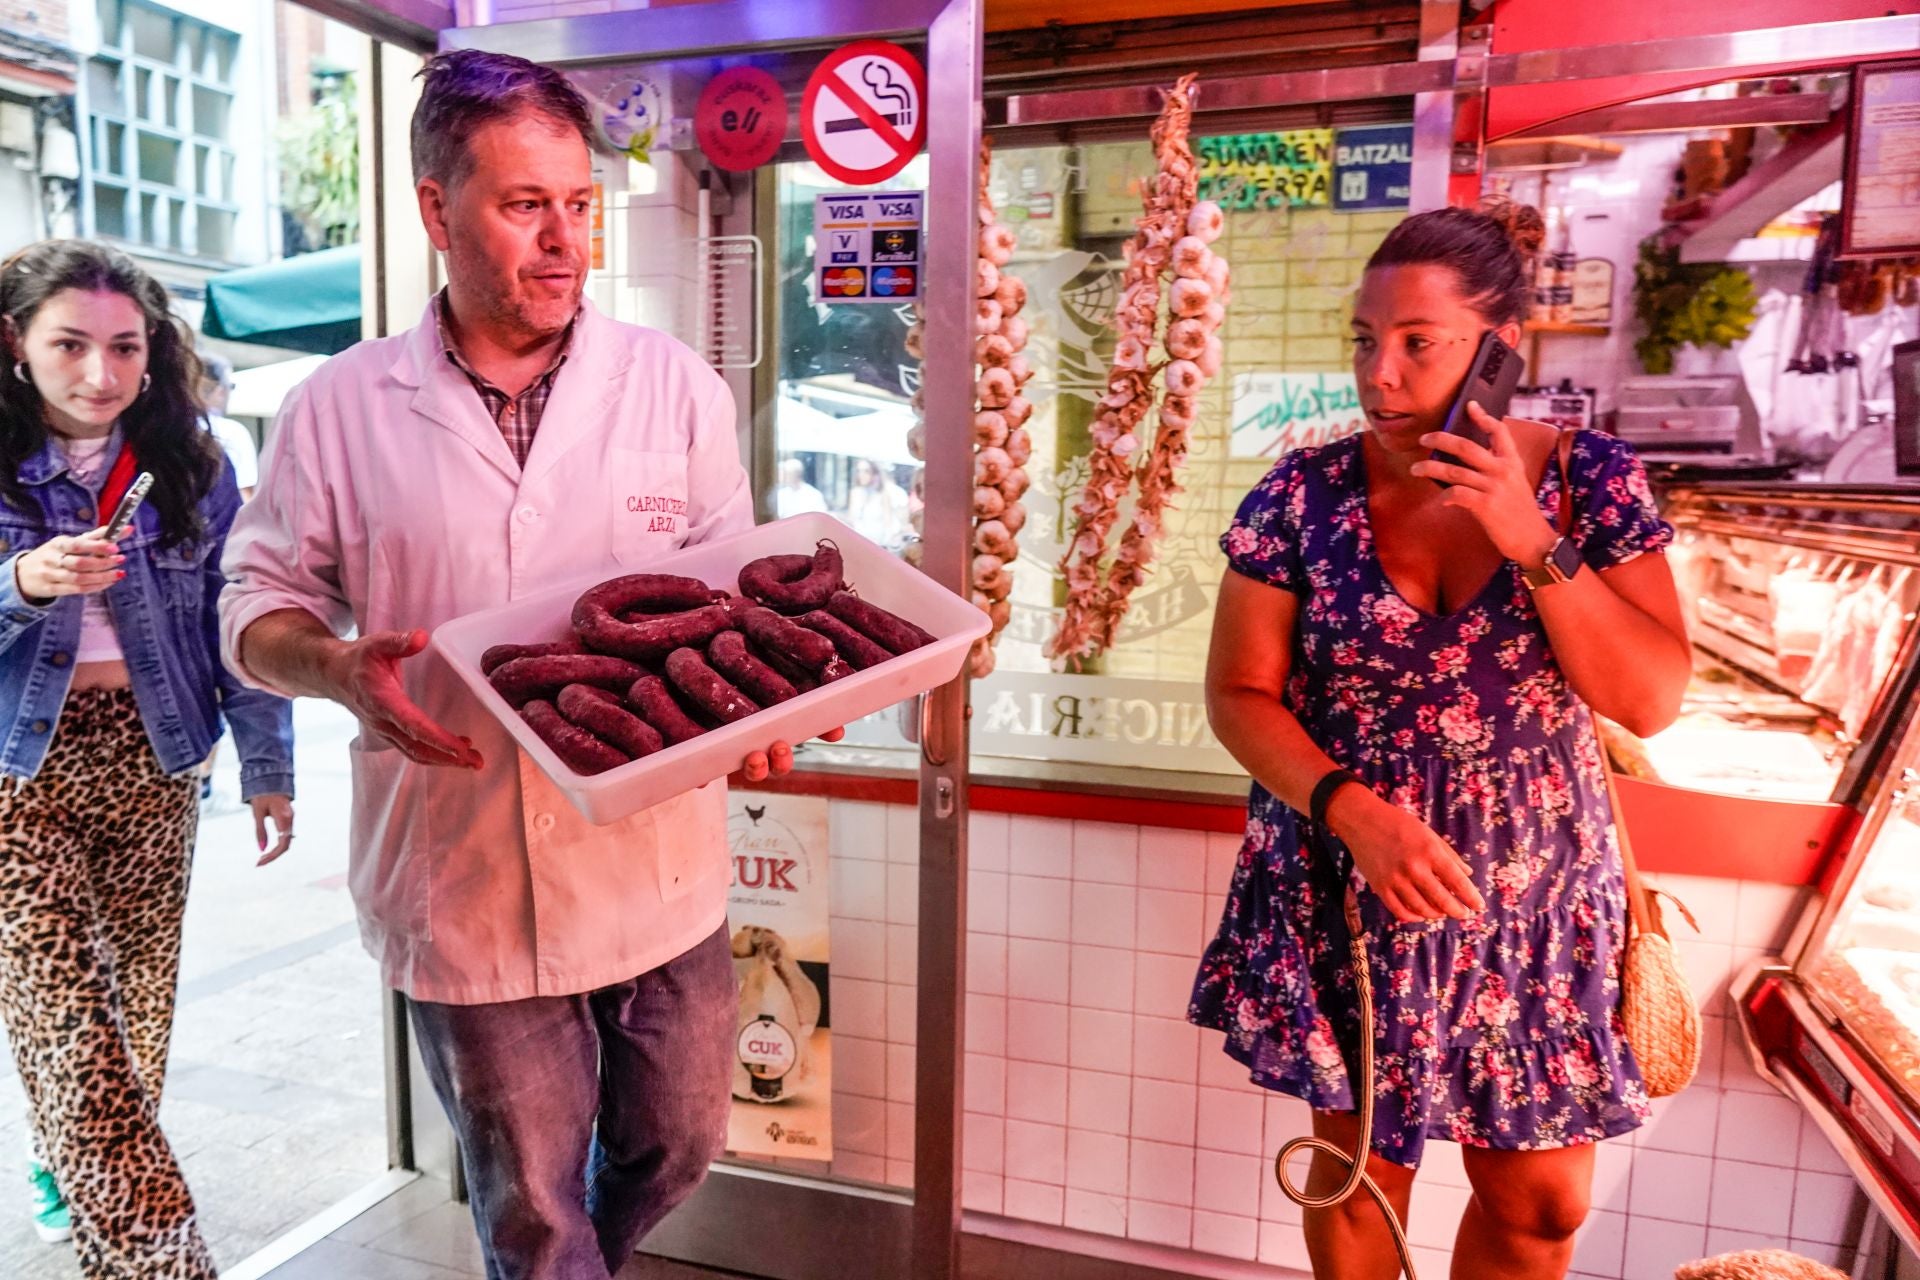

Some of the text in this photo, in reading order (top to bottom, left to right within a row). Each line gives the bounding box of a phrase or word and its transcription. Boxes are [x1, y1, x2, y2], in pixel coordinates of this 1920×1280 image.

[828, 205, 864, 219] VISA
[878, 202, 914, 216] VISA
[838, 235, 852, 248] V
[729, 854, 799, 893] UK
[748, 1040, 783, 1056] CUK
